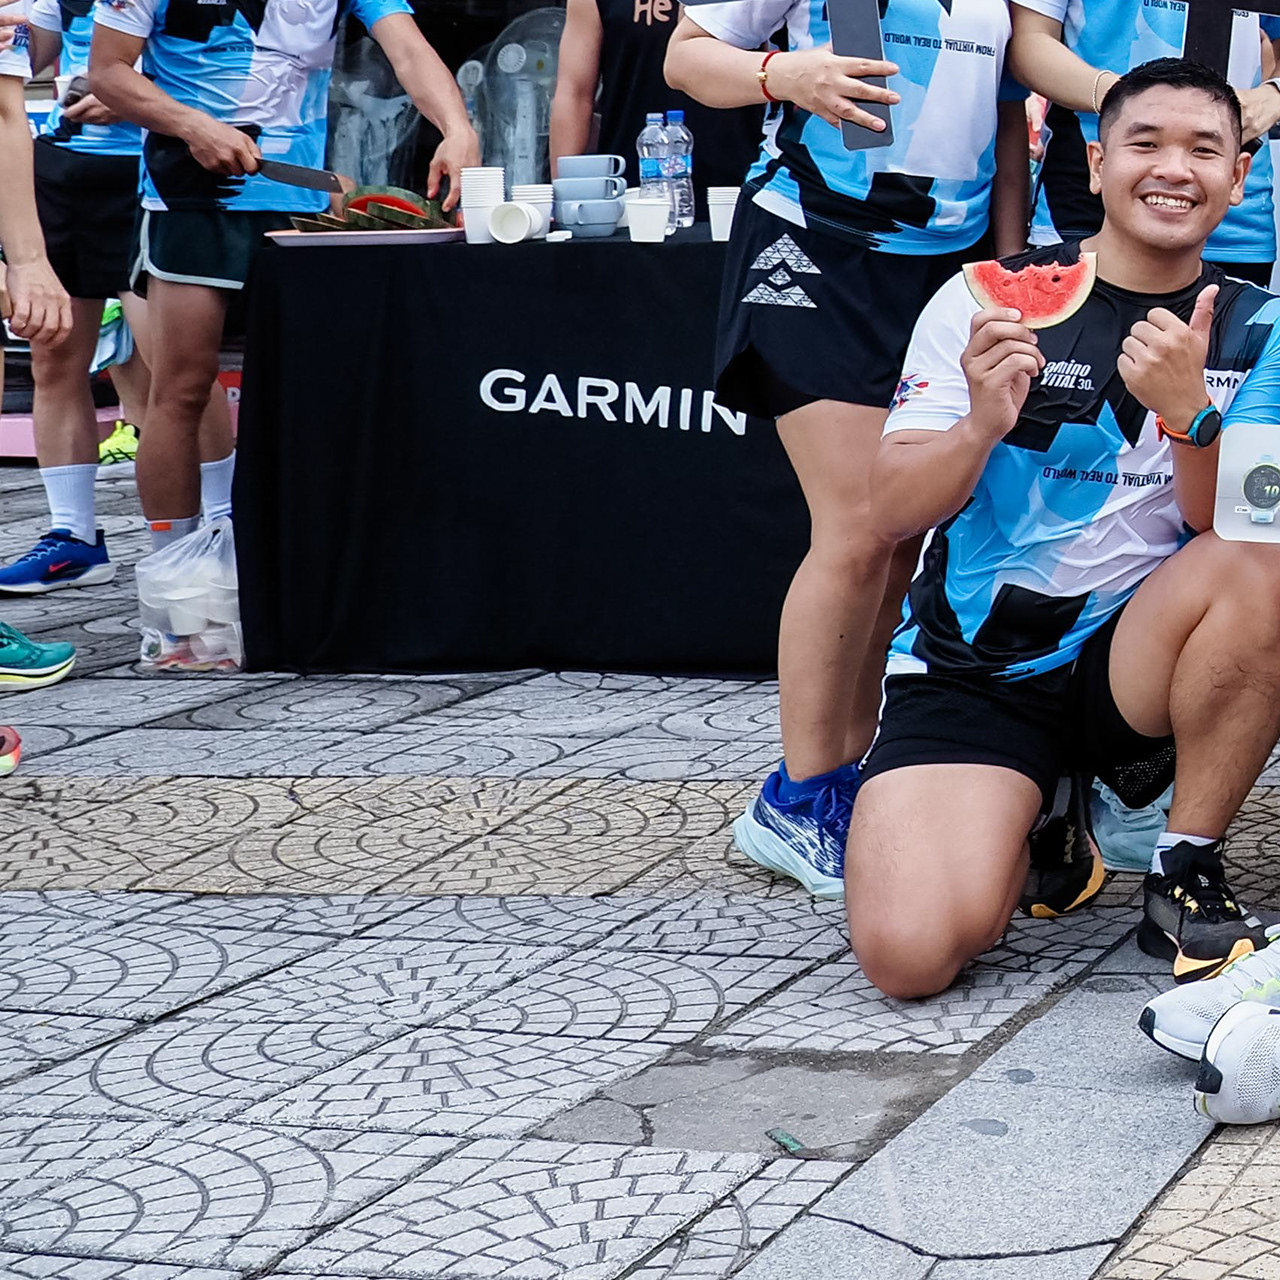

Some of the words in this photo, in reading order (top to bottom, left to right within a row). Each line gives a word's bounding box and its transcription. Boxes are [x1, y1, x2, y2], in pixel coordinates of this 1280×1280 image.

[1043, 359, 1092, 378] amino
[1040, 373, 1076, 389] VITAL
[479, 369, 747, 436] GARMIN
[1080, 470, 1103, 483] REAL
[1105, 473, 1119, 484] TO
[1122, 472, 1163, 487] VIRTUAL
[1263, 485, 1280, 496] 10
